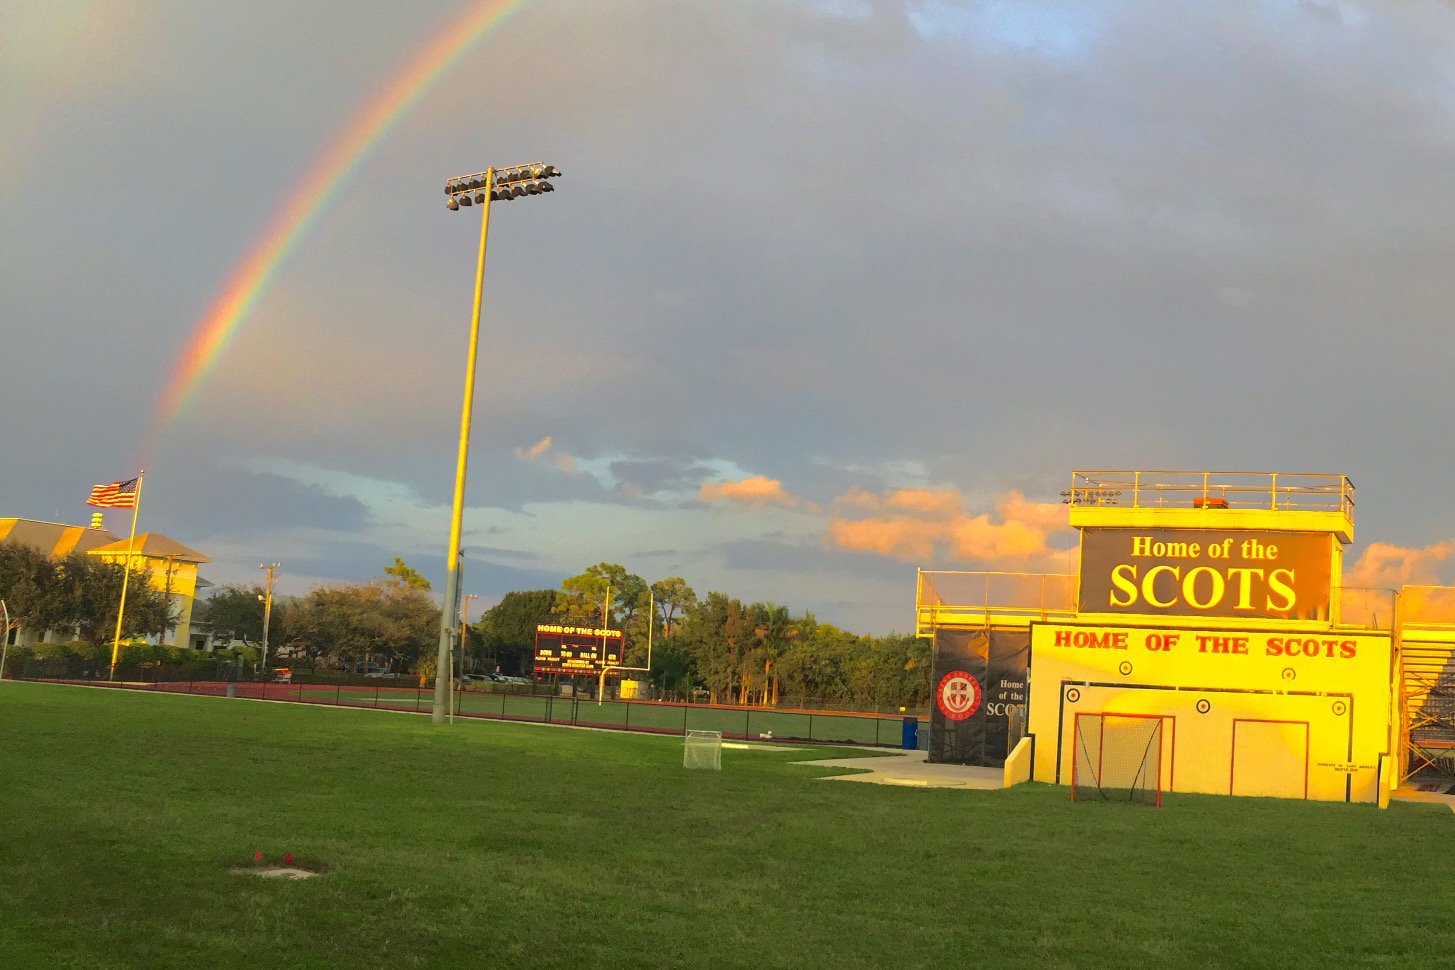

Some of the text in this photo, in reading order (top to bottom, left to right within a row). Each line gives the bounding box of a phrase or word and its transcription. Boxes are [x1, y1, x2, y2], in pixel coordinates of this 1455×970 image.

[1131, 536, 1278, 559] Home of the
[1109, 564, 1297, 611] SCOTS
[537, 625, 621, 637] HOME OF THE SCOTS
[1054, 630, 1357, 659] HOME OF THE SCOTS
[1000, 680, 1024, 688] Home
[998, 692, 1024, 700] of the
